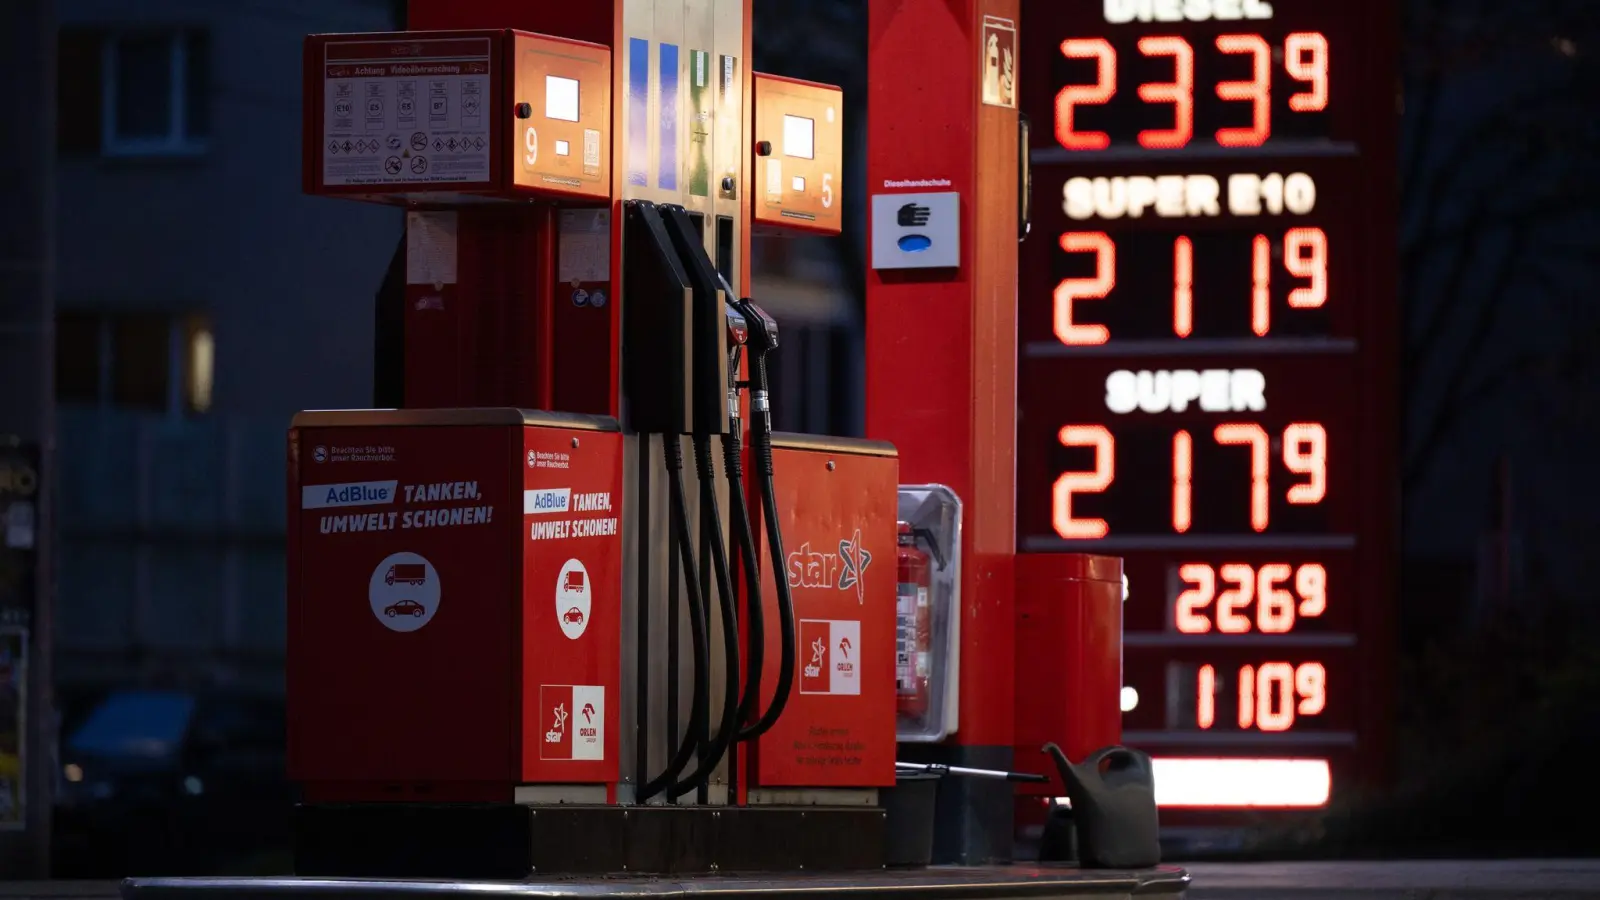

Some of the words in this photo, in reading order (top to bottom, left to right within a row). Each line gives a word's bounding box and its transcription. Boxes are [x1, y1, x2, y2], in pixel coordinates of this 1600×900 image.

[355, 66, 385, 76] Achtung
[336, 104, 350, 112] E10
[525, 126, 538, 166] 9
[821, 173, 833, 208] 5
[883, 178, 952, 188] Dieselhandschuhe
[1062, 174, 1221, 220] SUPER
[1227, 171, 1317, 217] E10
[1105, 368, 1267, 414] SUPER
[403, 480, 483, 504] TANKEN,
[573, 492, 612, 512] TANKEN,
[320, 511, 398, 534] UMWELT
[401, 506, 494, 529] SCHONEN!
[531, 520, 571, 541] UMWELT
[571, 517, 618, 538] SCHONEN!
[788, 542, 837, 588] star
[804, 663, 821, 677] star
[545, 728, 562, 743] star
[580, 727, 597, 737] ORLEN
